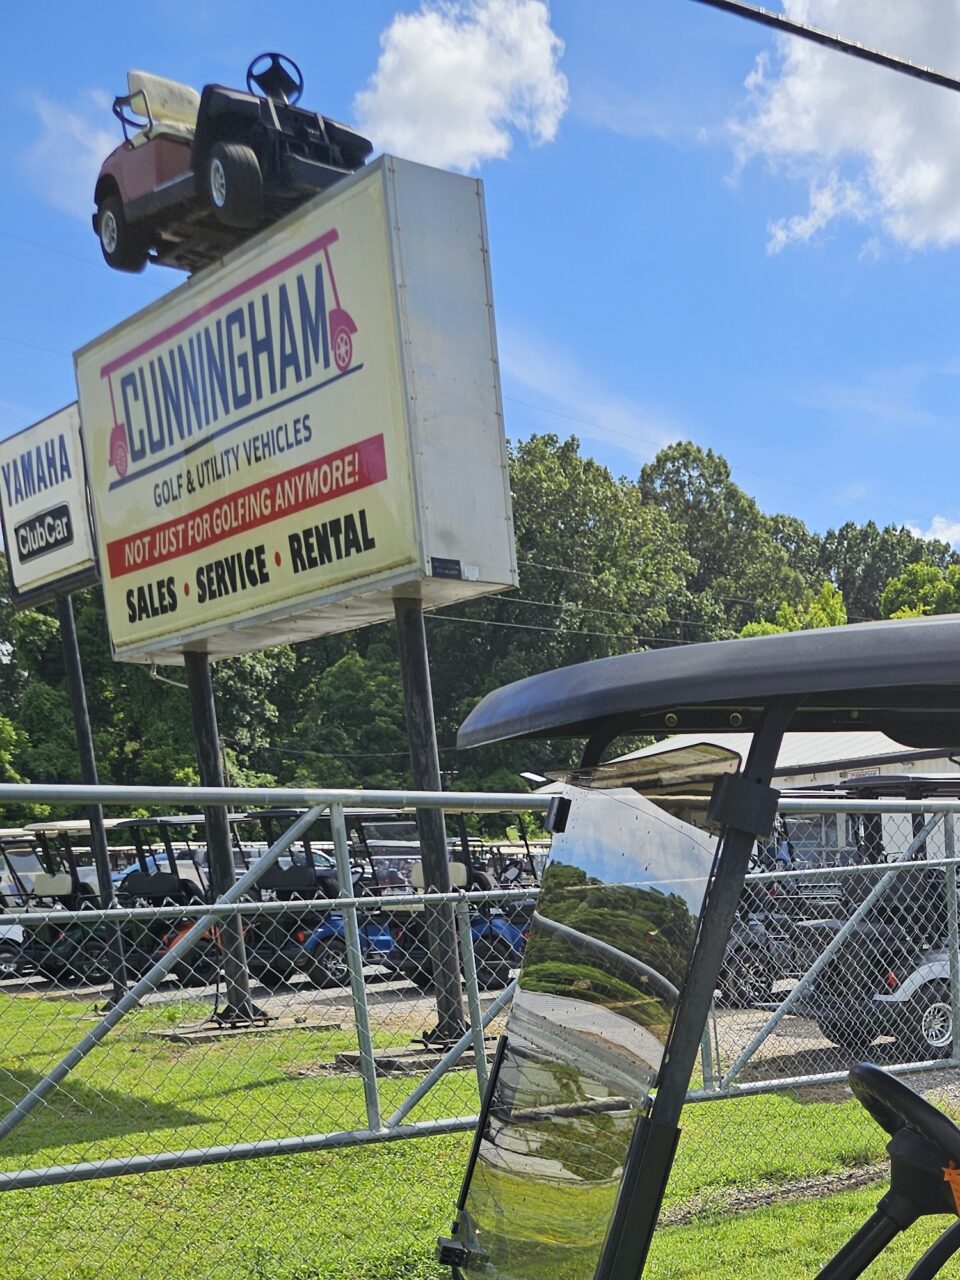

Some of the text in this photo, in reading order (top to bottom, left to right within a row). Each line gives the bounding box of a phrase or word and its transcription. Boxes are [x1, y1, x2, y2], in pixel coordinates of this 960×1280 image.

[121, 263, 331, 463] CUNNINGHAM
[1, 433, 72, 508] YAMAHA
[125, 452, 360, 568] NOT JUST FOR GOLFING ANYMORE!
[153, 414, 312, 508] GOLF & UTILITY VEHICLES
[126, 508, 376, 623] SALES SERVICE RENTAL
